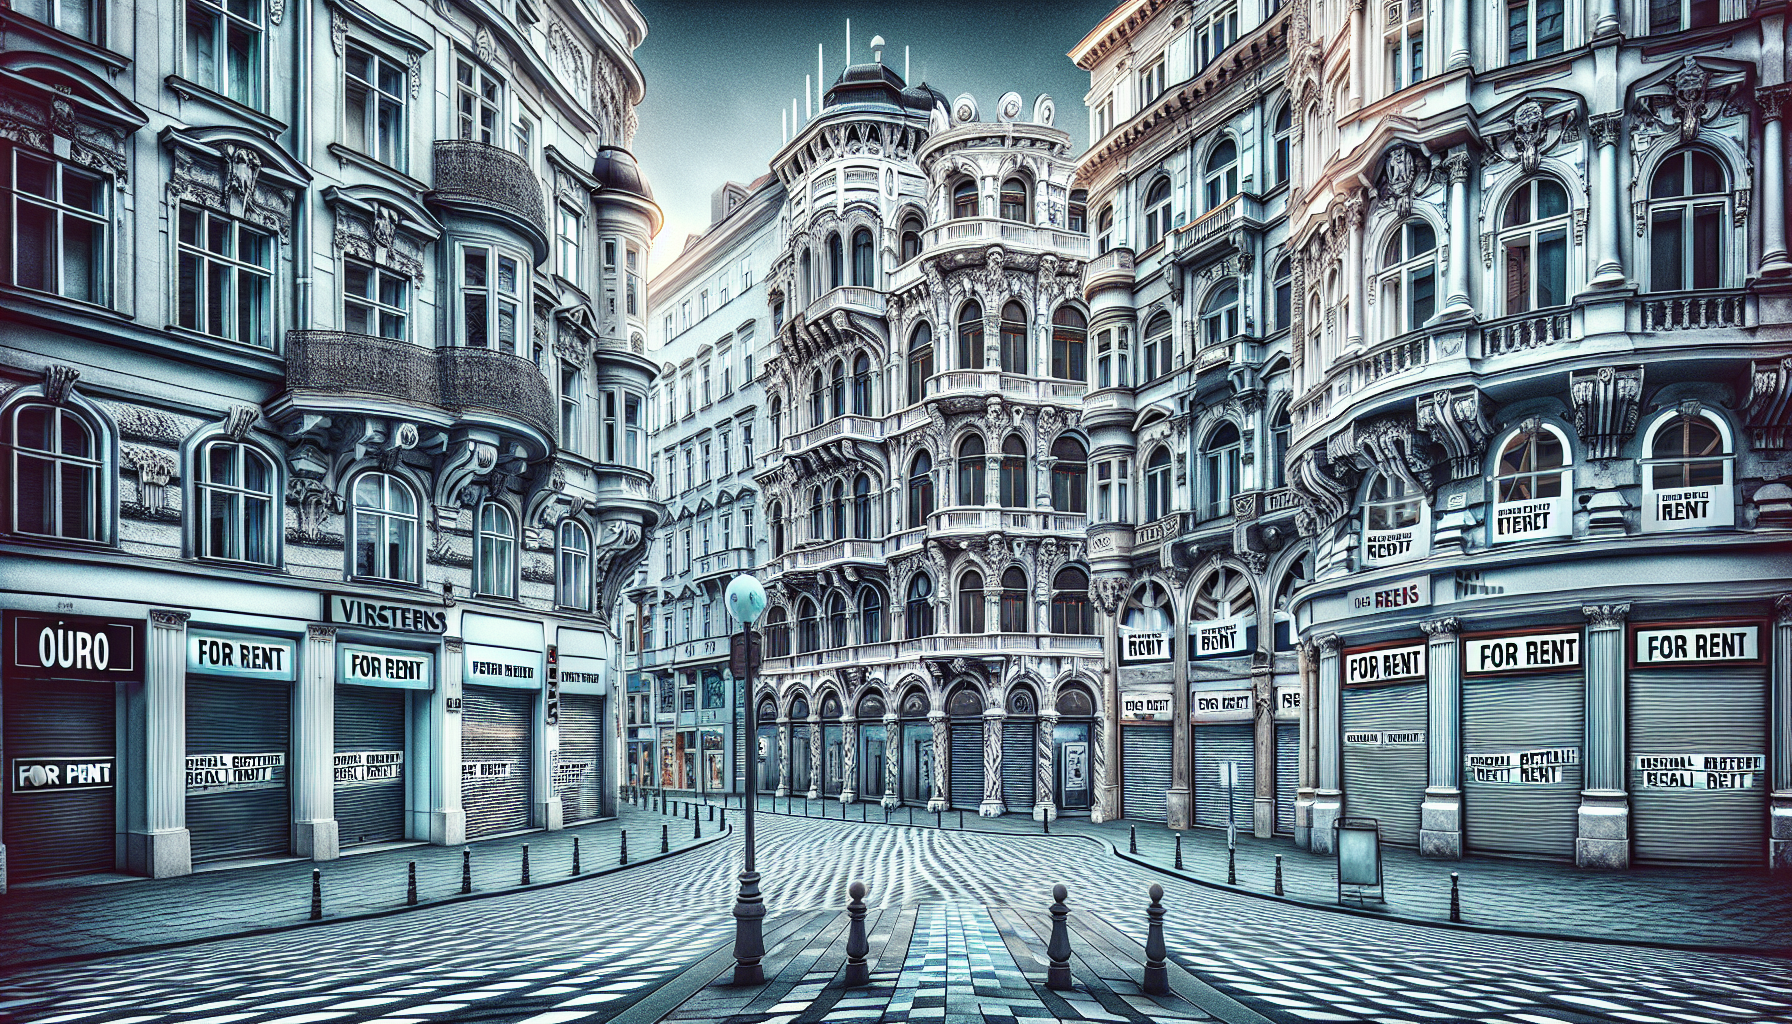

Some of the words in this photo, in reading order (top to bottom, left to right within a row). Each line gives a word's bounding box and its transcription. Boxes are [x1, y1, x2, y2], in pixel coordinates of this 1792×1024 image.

[199, 639, 233, 666] FOR
[240, 644, 285, 670] RENT
[1481, 643, 1518, 670] FOR
[1526, 639, 1577, 665] RENT
[1648, 635, 1687, 661] FOR
[1696, 632, 1747, 658] RENT
[352, 654, 381, 678] FOR
[1350, 656, 1379, 681] FOR
[1383, 651, 1420, 677] RENT
[19, 765, 59, 787] FOR
